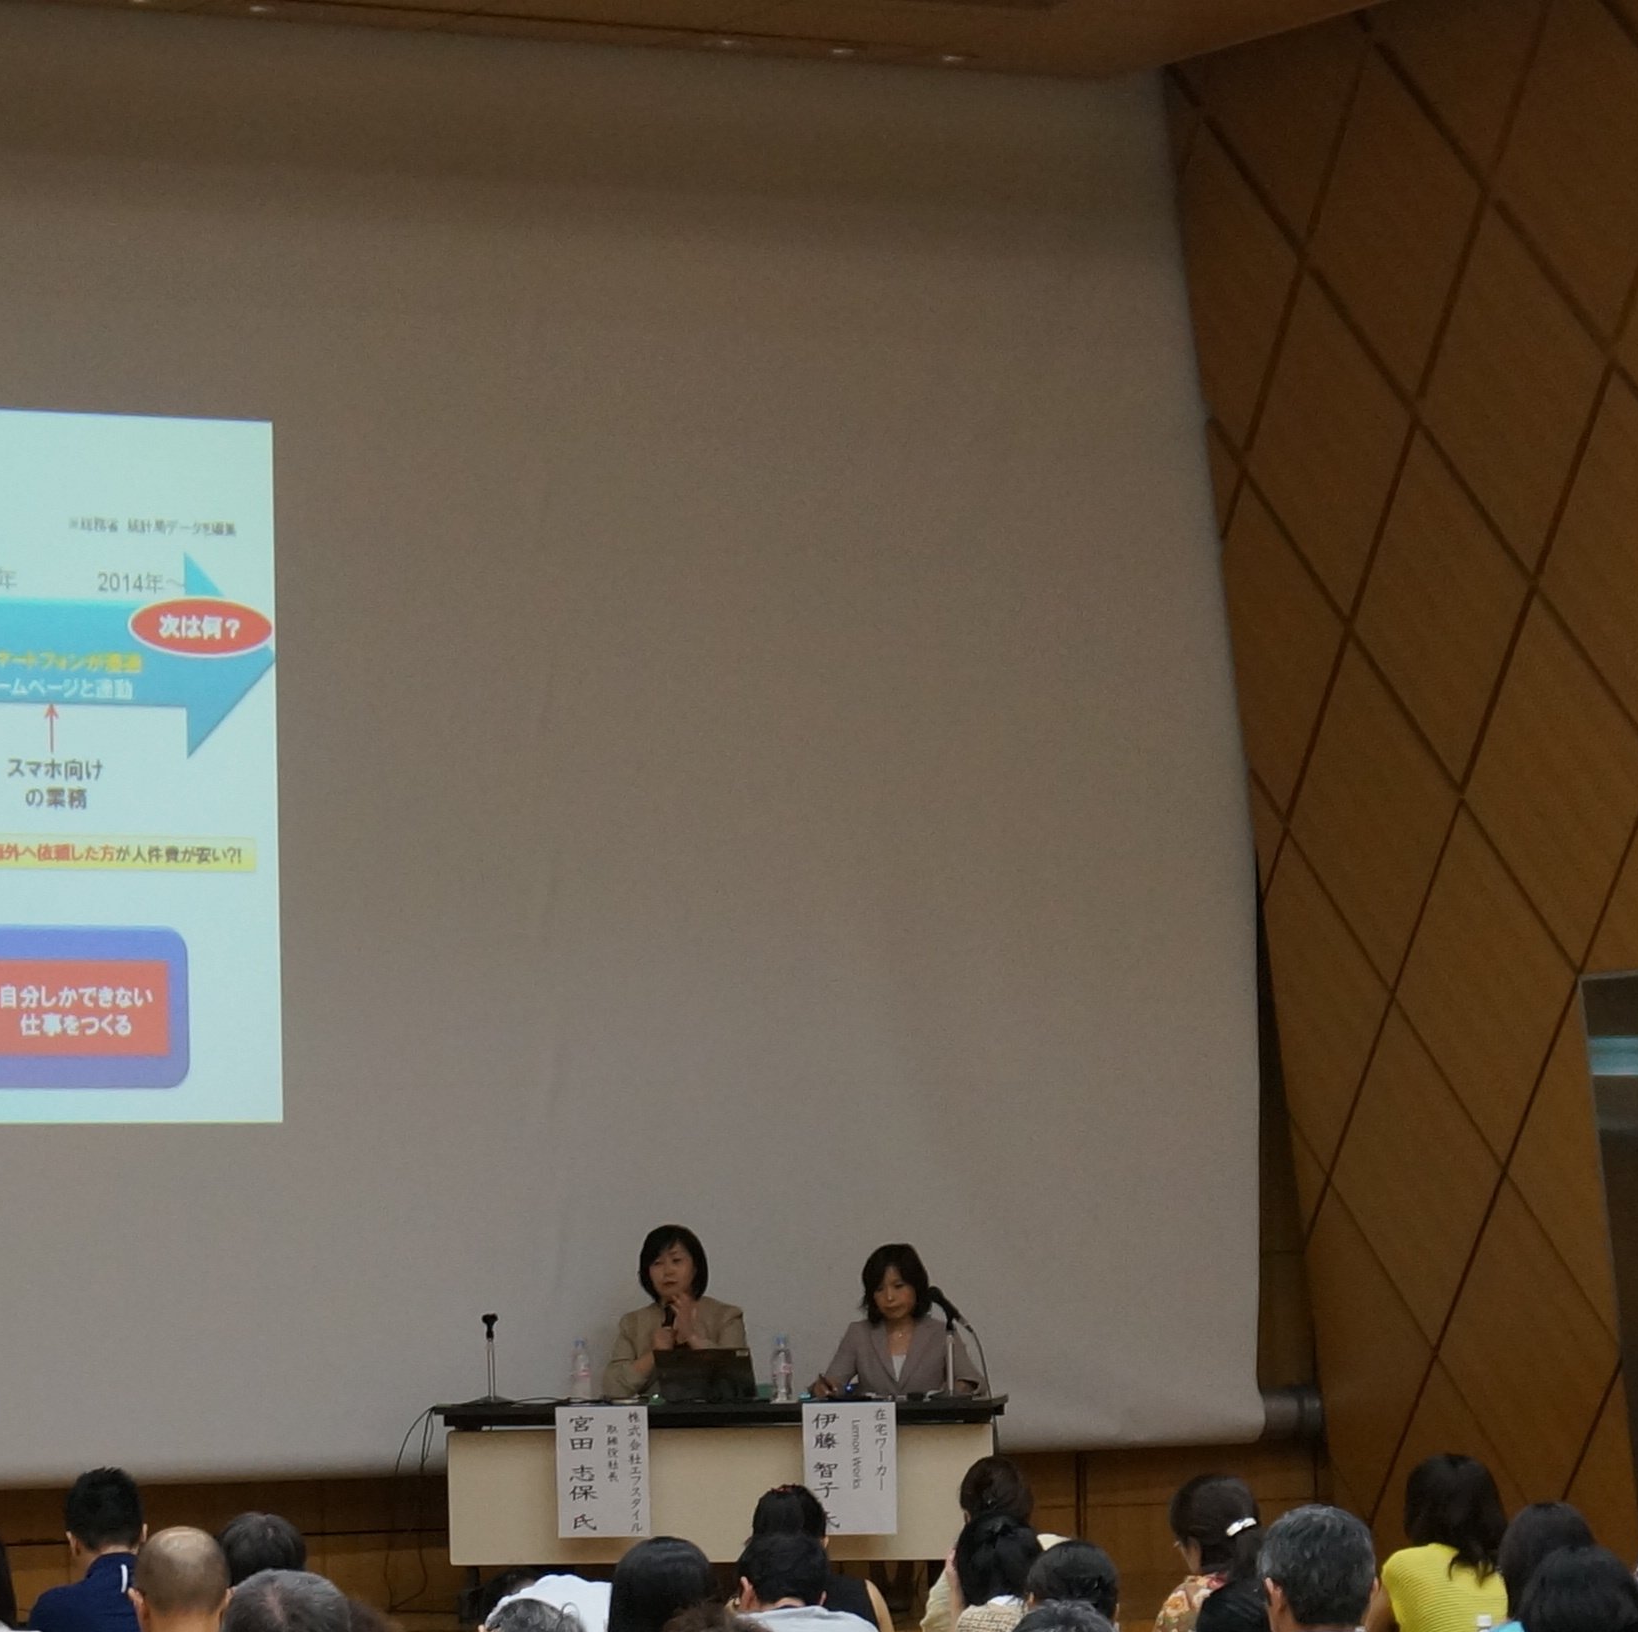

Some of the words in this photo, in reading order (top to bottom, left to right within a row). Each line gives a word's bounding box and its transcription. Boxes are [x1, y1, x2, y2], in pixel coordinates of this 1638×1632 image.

[6, 757, 104, 781] スマホ向け
[25, 786, 88, 811] の業務
[0, 984, 154, 1009] 自分しかできない
[19, 1012, 133, 1038] 仕事をつくる
[568, 1415, 595, 1451] 宮田
[811, 1412, 840, 1451] 伊藤
[873, 1407, 889, 1492] 在宅ワーカー
[569, 1463, 599, 1502] 志保
[813, 1461, 840, 1499] 智子
[572, 1512, 598, 1532] 氏
